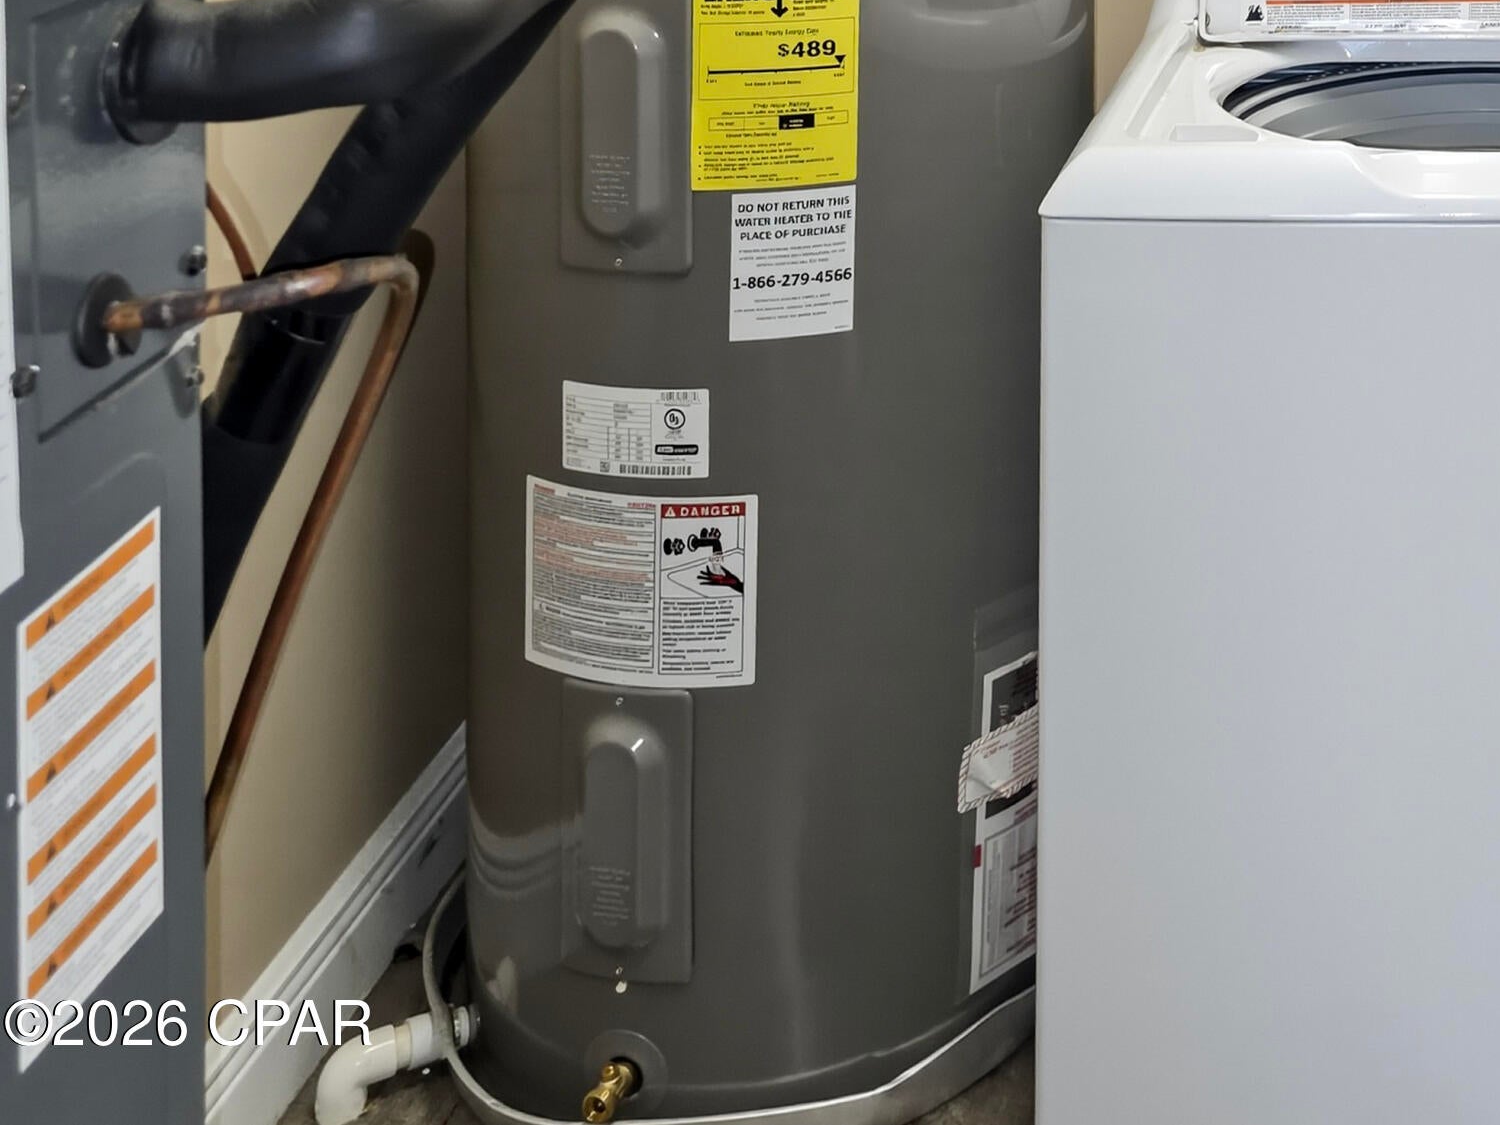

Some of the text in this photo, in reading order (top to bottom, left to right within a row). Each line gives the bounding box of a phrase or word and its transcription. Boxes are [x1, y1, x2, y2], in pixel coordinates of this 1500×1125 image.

[777, 39, 836, 58] $489
[738, 196, 850, 213] DO NOT RETURN THIS
[735, 209, 852, 227] WATER HEATER TO THE
[740, 224, 846, 241] PLACE OF PURCHASE
[732, 267, 852, 290] 1-866-279-4566
[680, 504, 740, 517] DANGER
